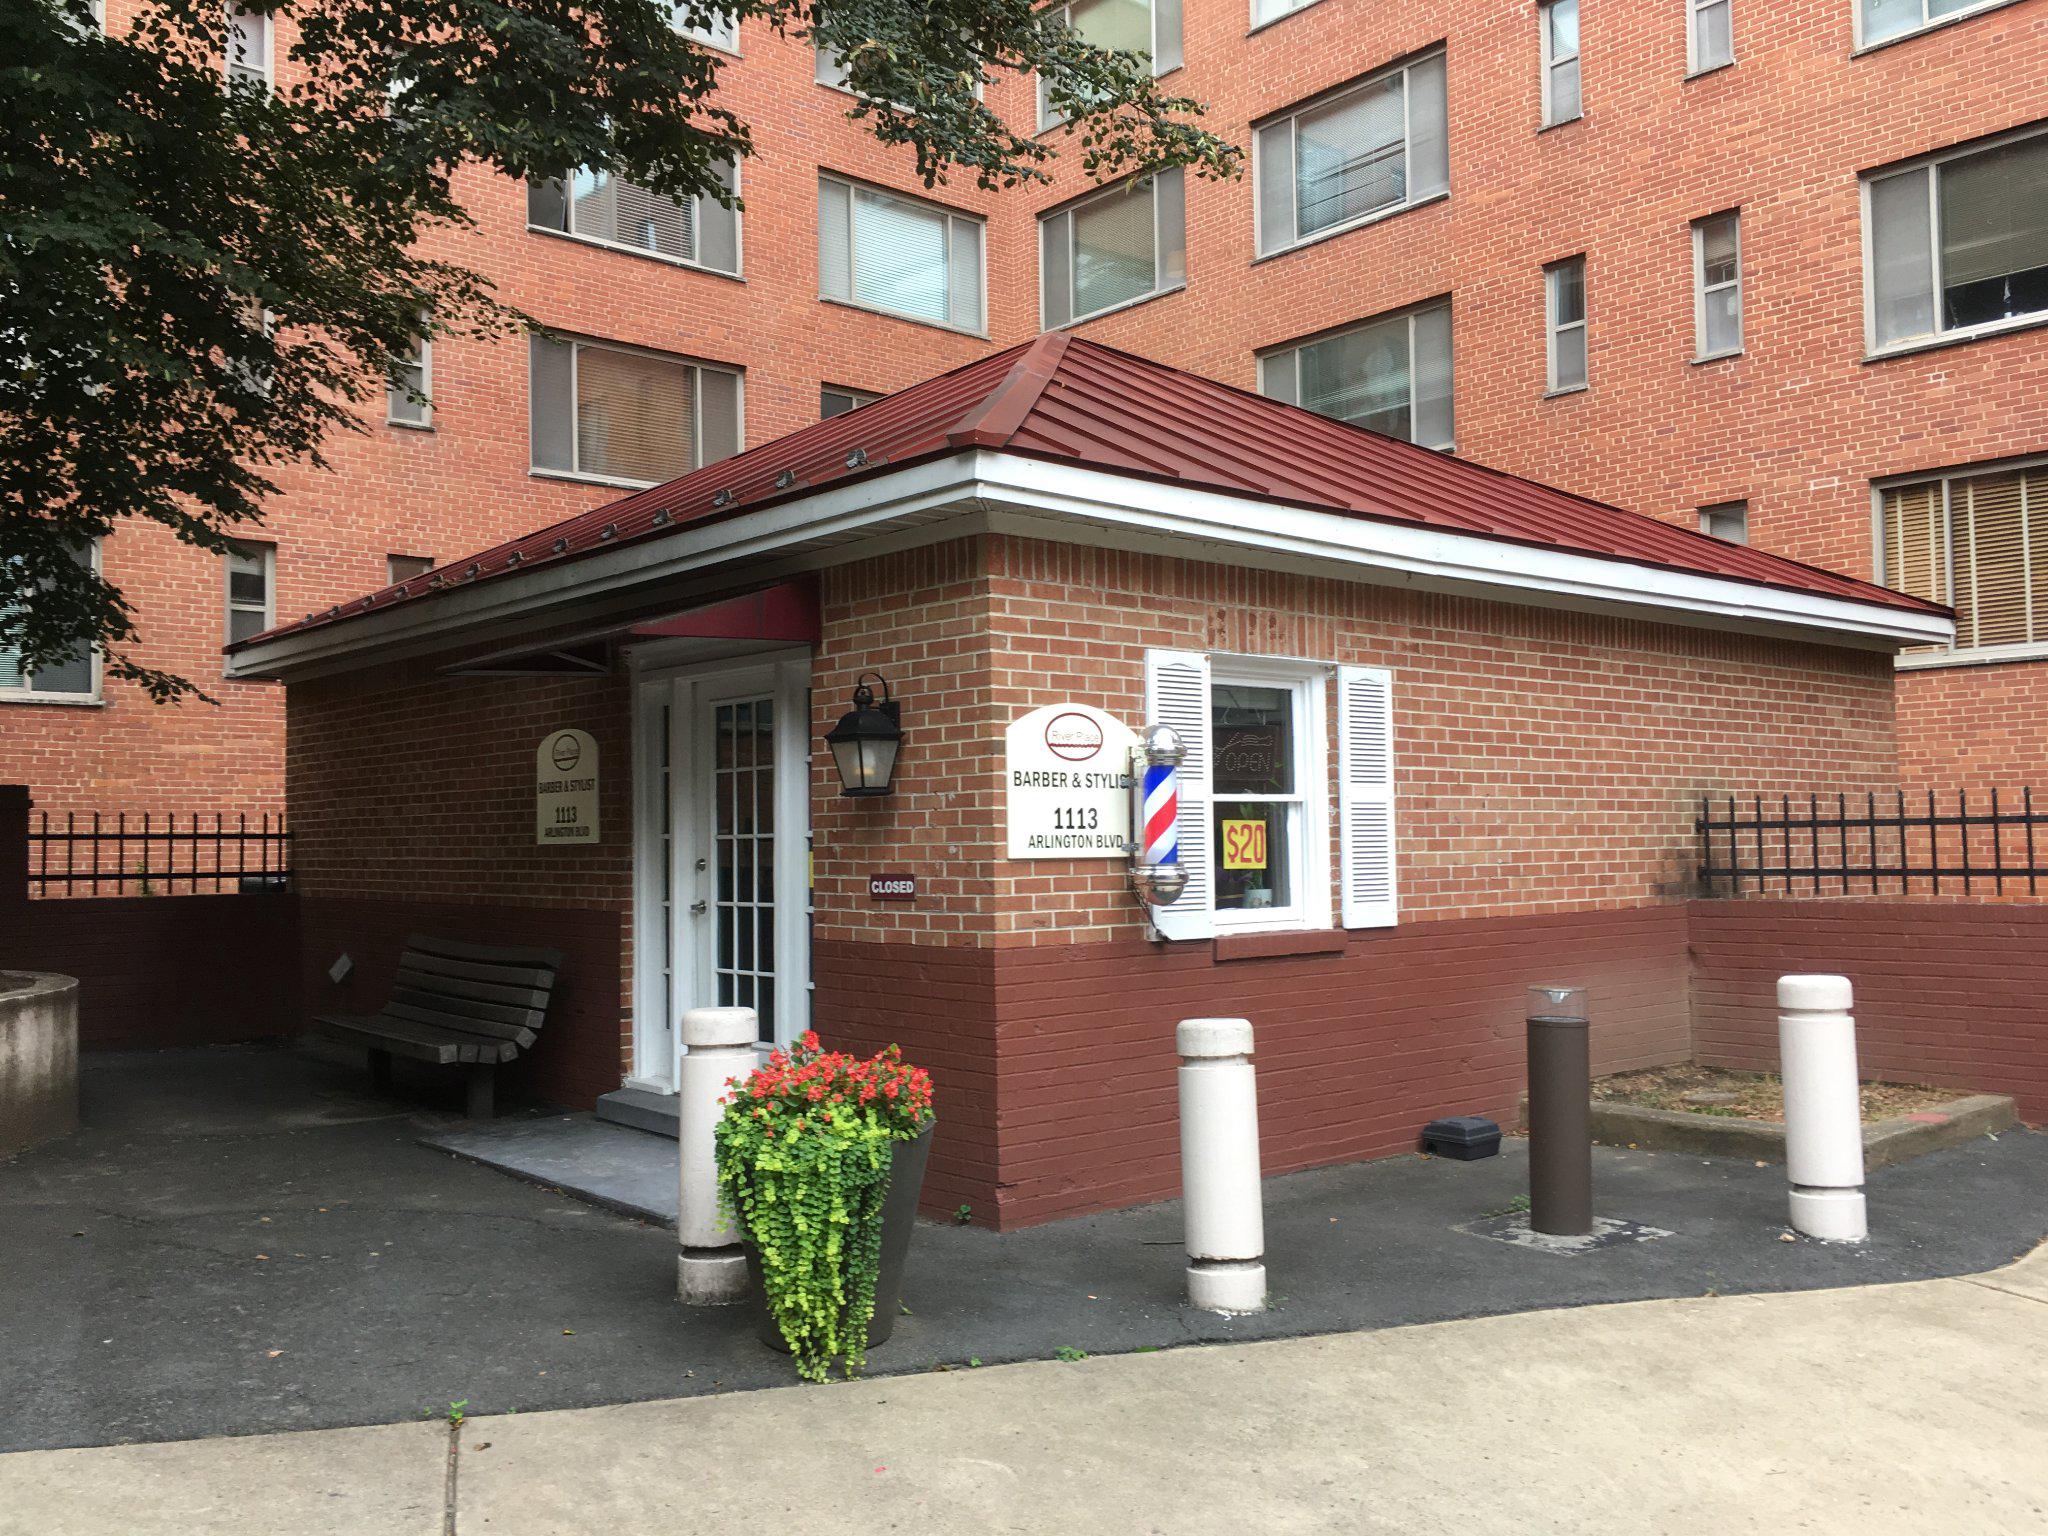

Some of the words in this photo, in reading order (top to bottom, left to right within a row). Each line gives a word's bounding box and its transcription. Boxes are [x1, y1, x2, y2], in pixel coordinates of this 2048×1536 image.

[1225, 752, 1271, 772] OPEN
[538, 781, 563, 793] BARBER
[564, 780, 569, 792] &
[570, 779, 595, 791] STYLIST
[1013, 770, 1068, 788] BARBER
[1072, 774, 1082, 788] &
[555, 806, 577, 823] 1113
[1054, 807, 1098, 830] 1113
[1028, 834, 1093, 849] ARLINGTON
[1096, 834, 1123, 848] BLVD
[1226, 824, 1265, 864] $20
[871, 880, 914, 893] CLOSED
